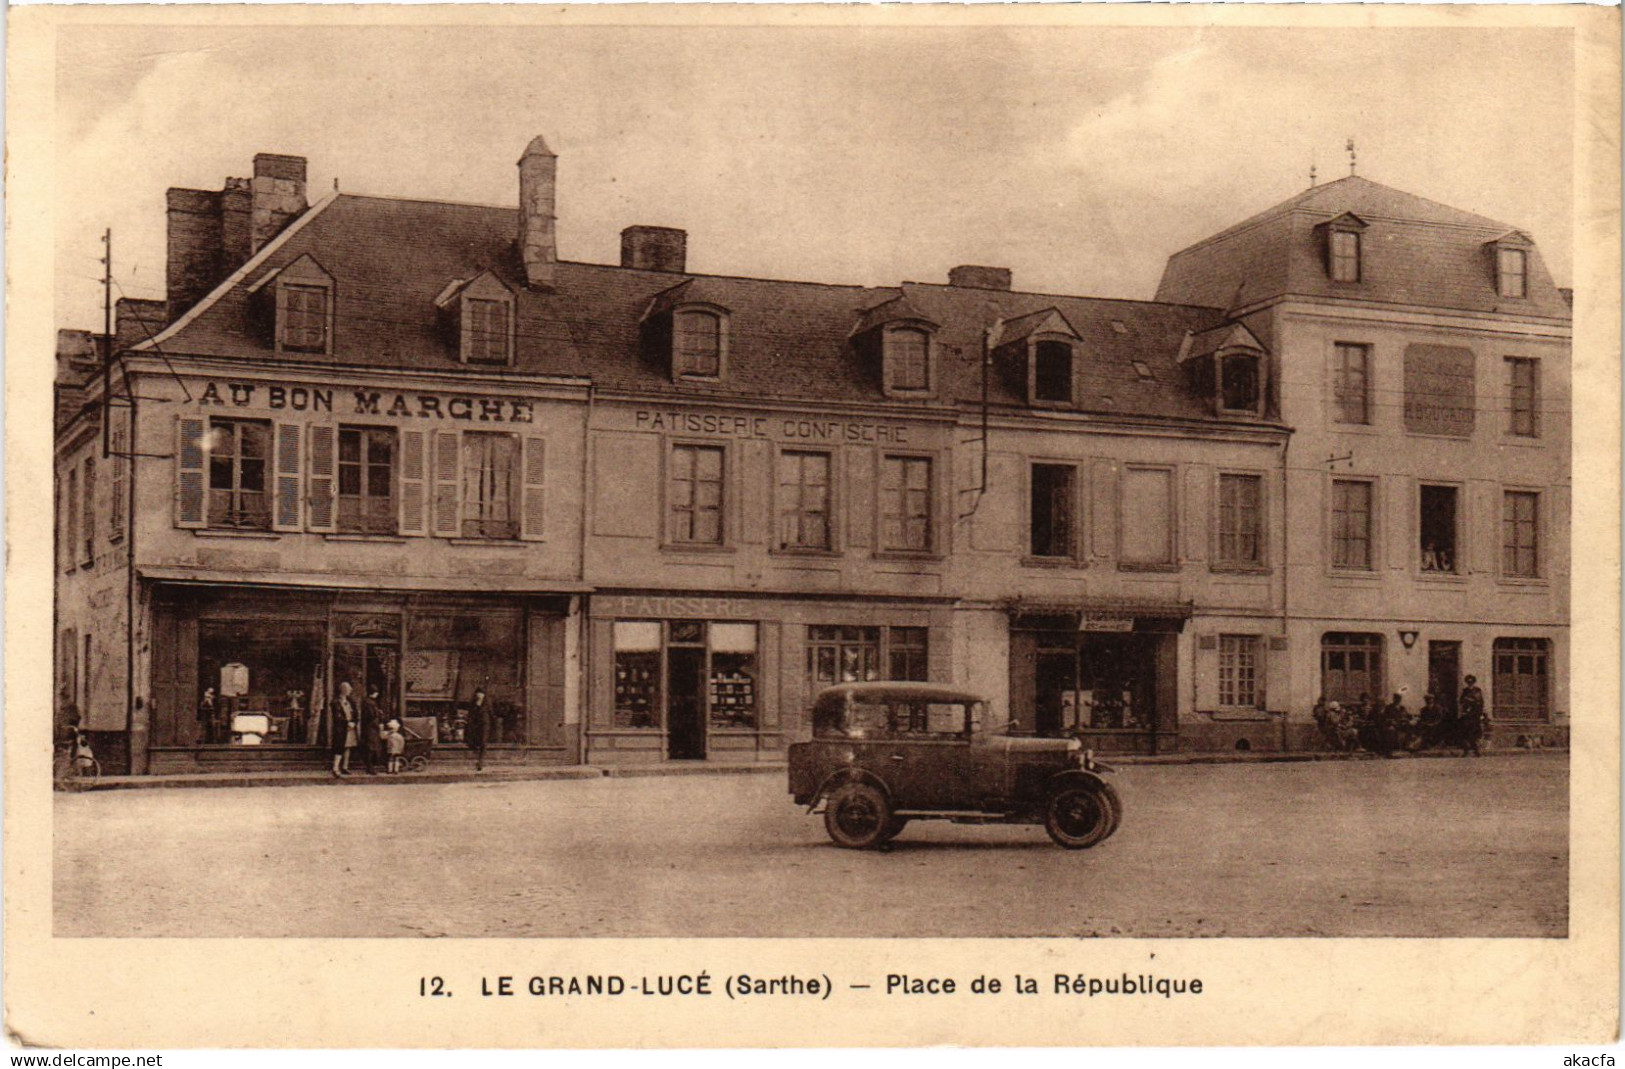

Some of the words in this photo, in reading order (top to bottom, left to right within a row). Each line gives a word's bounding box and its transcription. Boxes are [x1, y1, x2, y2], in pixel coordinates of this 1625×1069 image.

[199, 381, 255, 406] AU
[269, 386, 333, 412] BON
[636, 410, 767, 436] PATISSERIE
[783, 420, 907, 443] CONFISERIE
[621, 596, 752, 616] PATISSERIE
